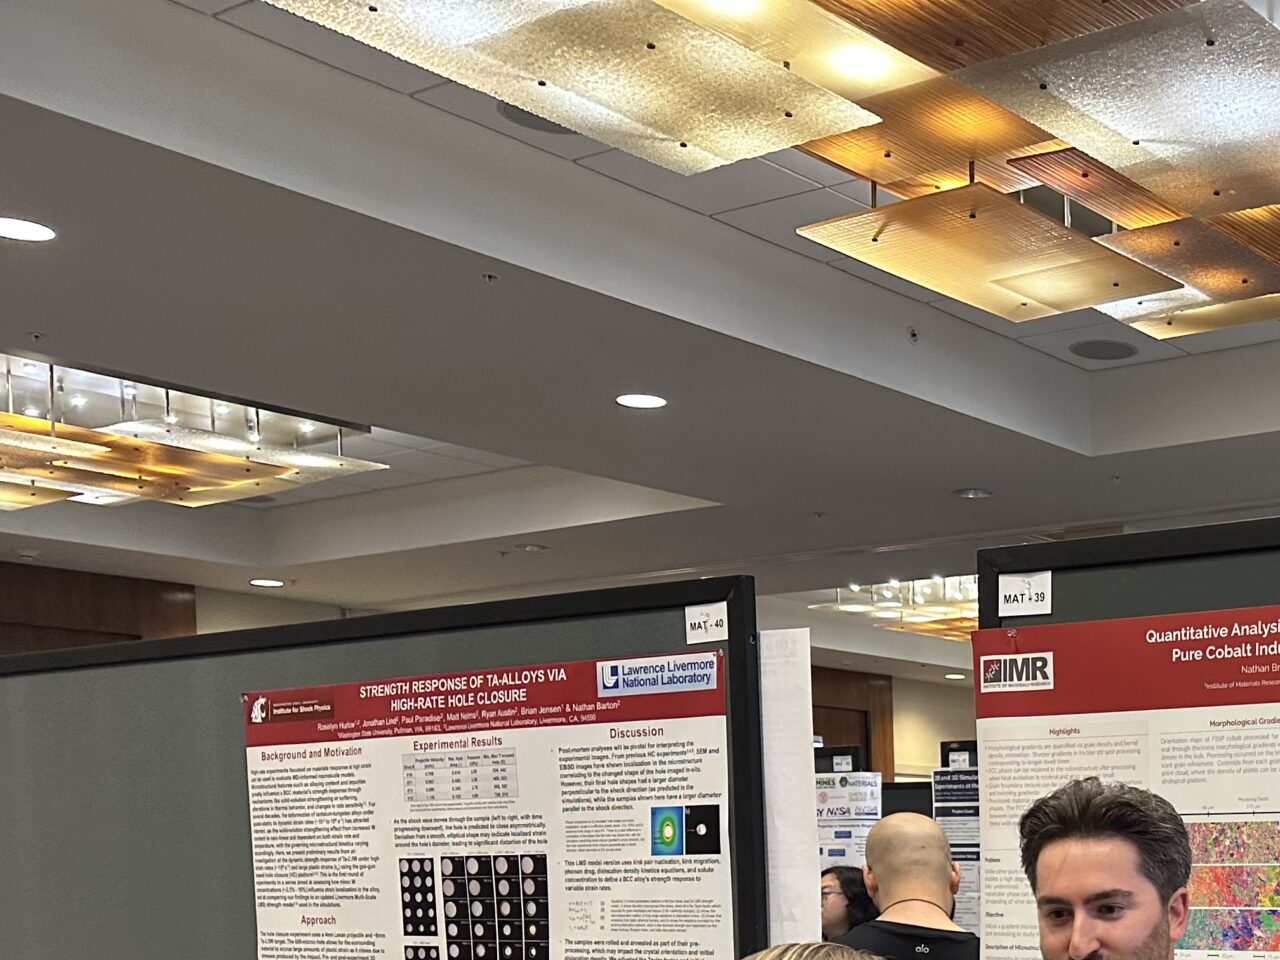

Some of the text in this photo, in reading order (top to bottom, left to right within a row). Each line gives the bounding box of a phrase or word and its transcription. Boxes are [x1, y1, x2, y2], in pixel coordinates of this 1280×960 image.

[1004, 593, 1026, 604] MAT
[1034, 592, 1045, 602] 39
[690, 620, 708, 632] MAT
[715, 618, 724, 628] 40
[1145, 625, 1228, 642] Quantitative
[1171, 648, 1203, 661] Pure
[1205, 643, 1252, 659] Cobalt
[621, 660, 715, 677] Lawrence Livermore
[1002, 656, 1049, 682] IMR
[1240, 664, 1270, 673] Nathan
[359, 669, 567, 697] STRENGTH RESPONSE OF TA-ALLOYS VIA
[621, 673, 711, 688] National Laboratory
[390, 688, 527, 711] HIGH-RATE HOLE CLOSURE
[1208, 718, 1258, 727] Morphological
[609, 726, 664, 738] Discussion
[1048, 727, 1081, 736] Highlights
[412, 738, 469, 751] Experimental
[470, 736, 503, 748] Results
[260, 746, 362, 761] Background and Motivation
[300, 915, 336, 926] Approach
[915, 944, 930, 954] alo
